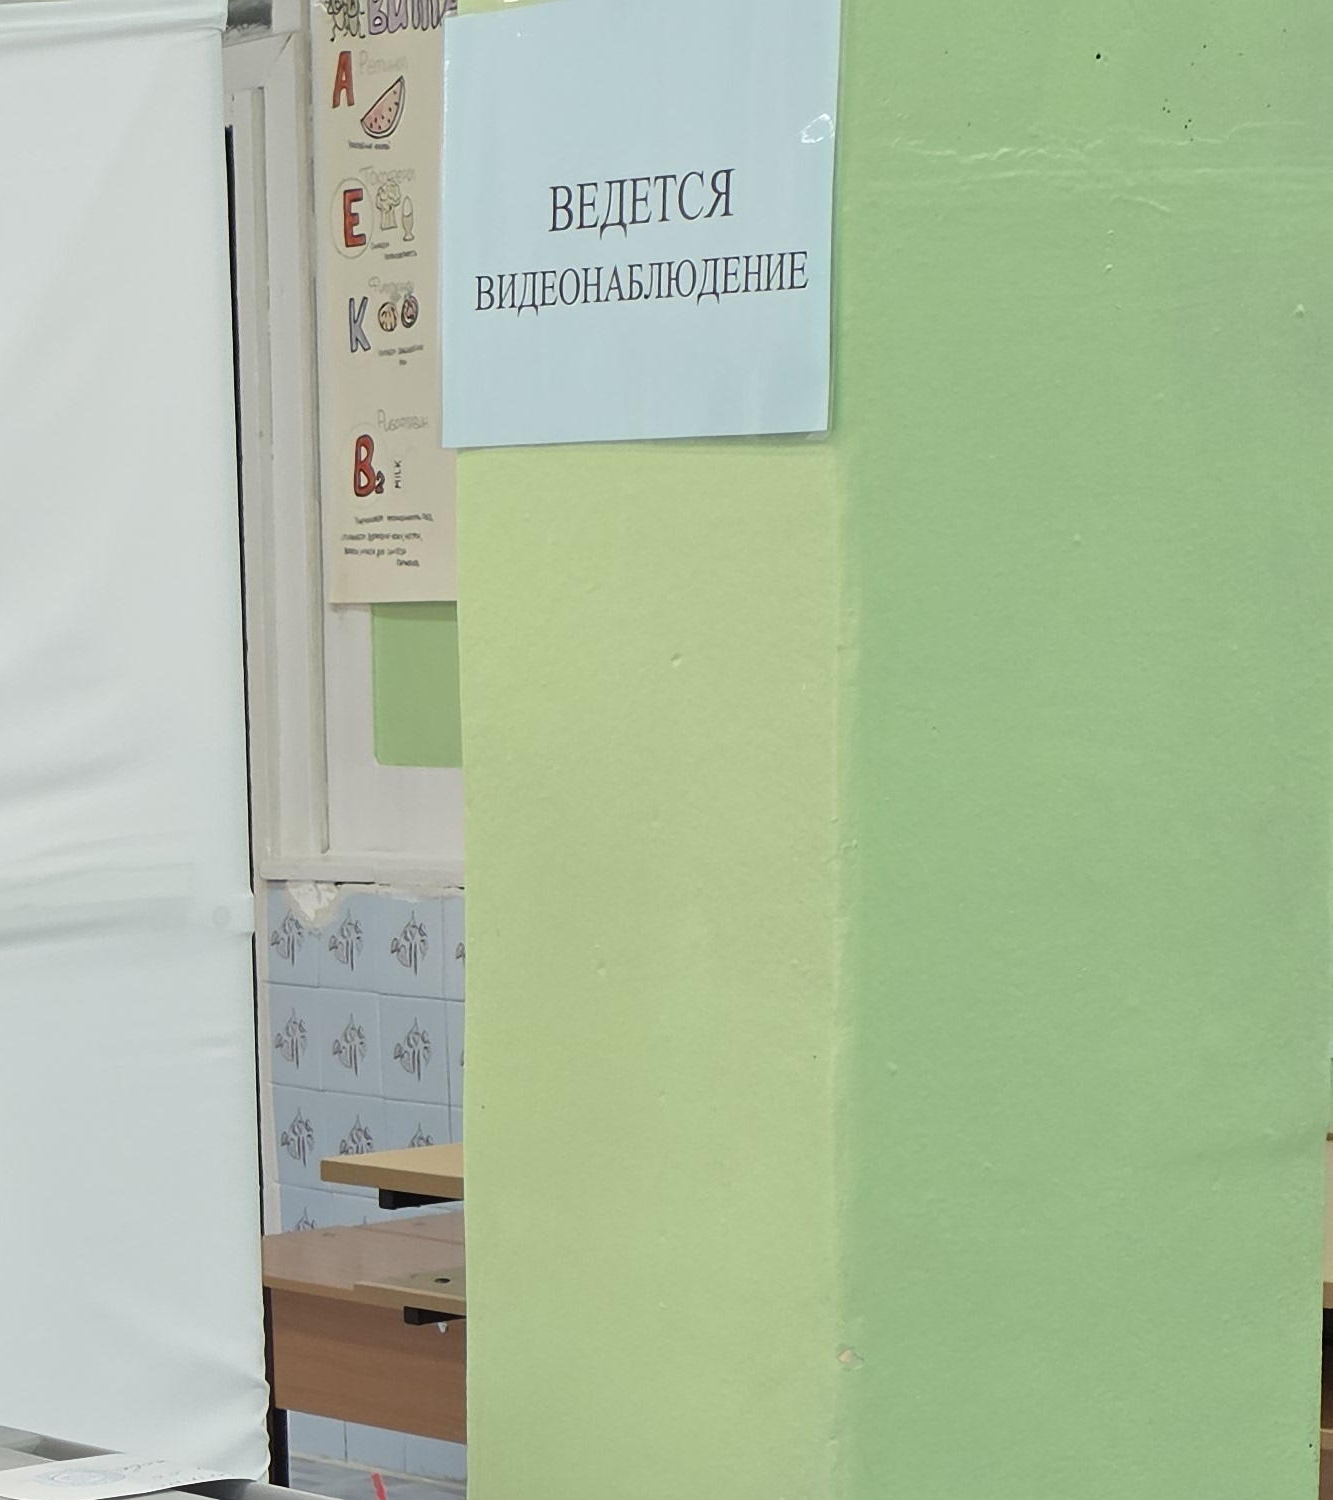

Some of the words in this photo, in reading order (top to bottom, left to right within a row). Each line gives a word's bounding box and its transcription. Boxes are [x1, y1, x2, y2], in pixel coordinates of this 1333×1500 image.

[548, 168, 736, 240] ВЕДЕТСЯ
[474, 250, 810, 316] ВИДЕОНАБЛЮДЕНИЕ
[394, 459, 402, 489] MILK
